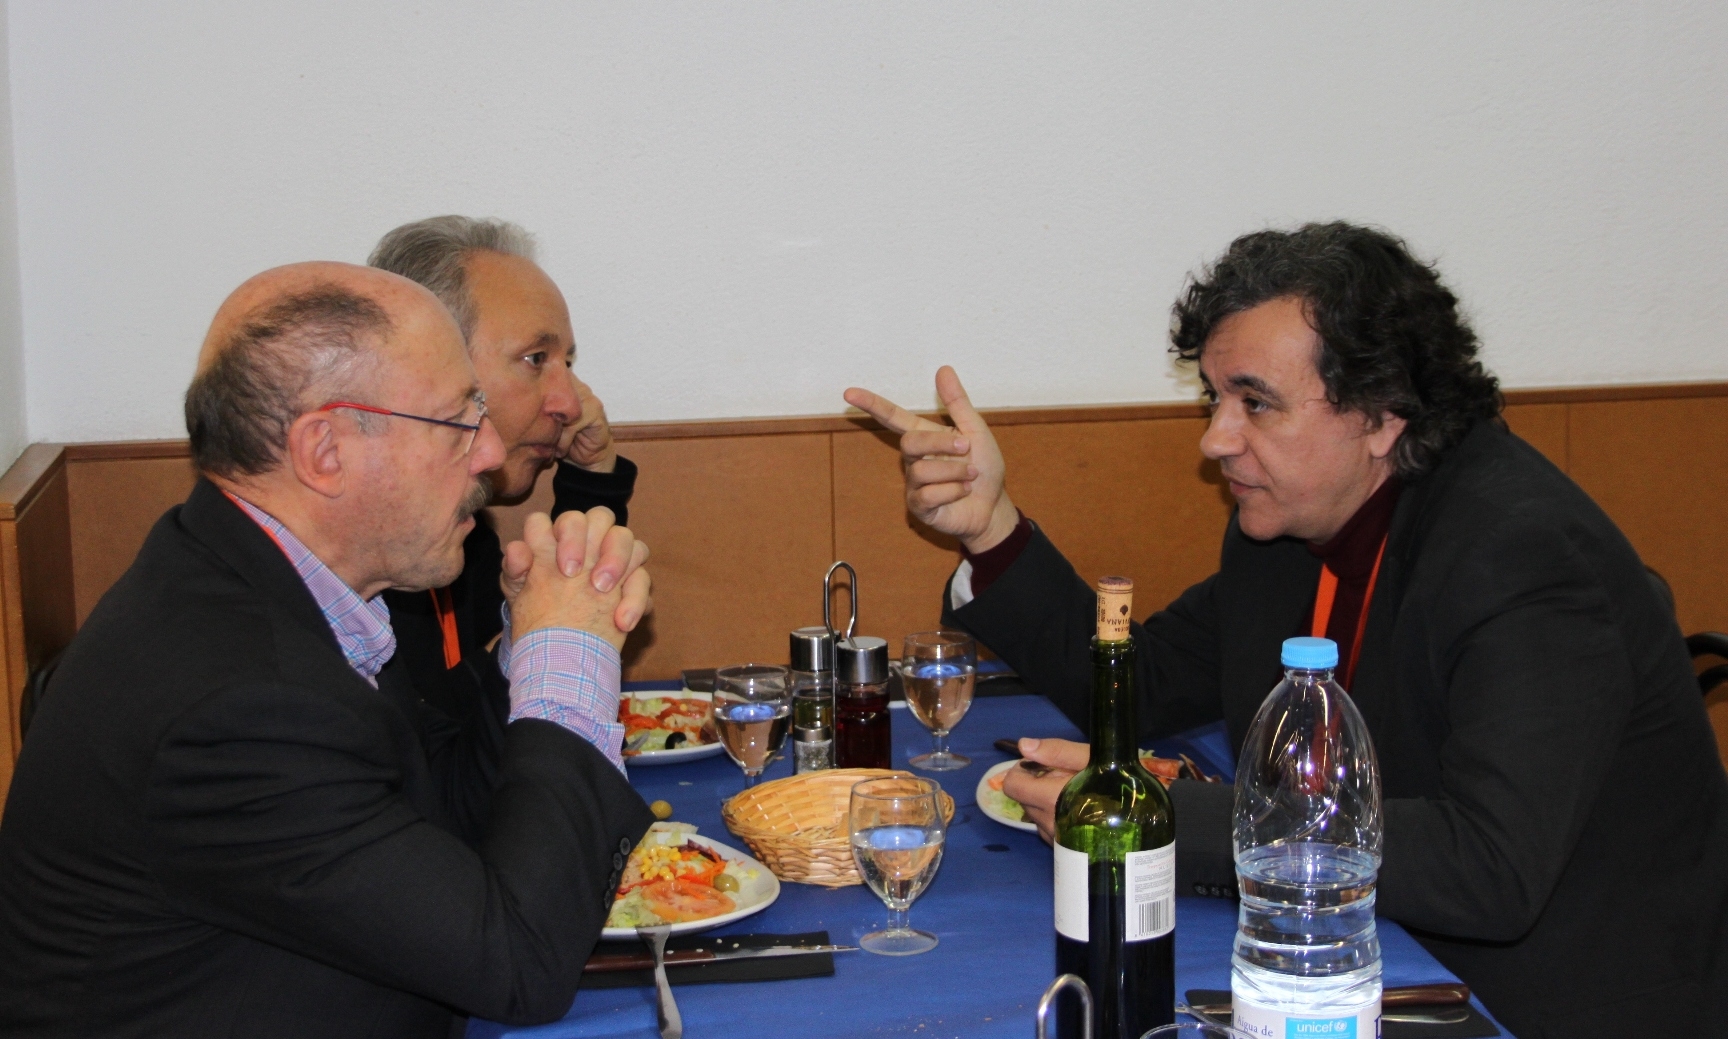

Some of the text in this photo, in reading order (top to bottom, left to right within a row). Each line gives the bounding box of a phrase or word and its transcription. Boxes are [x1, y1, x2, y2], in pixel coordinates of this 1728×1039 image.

[1237, 1015, 1274, 1037] Aigua de
[1297, 1021, 1333, 1033] unicef
